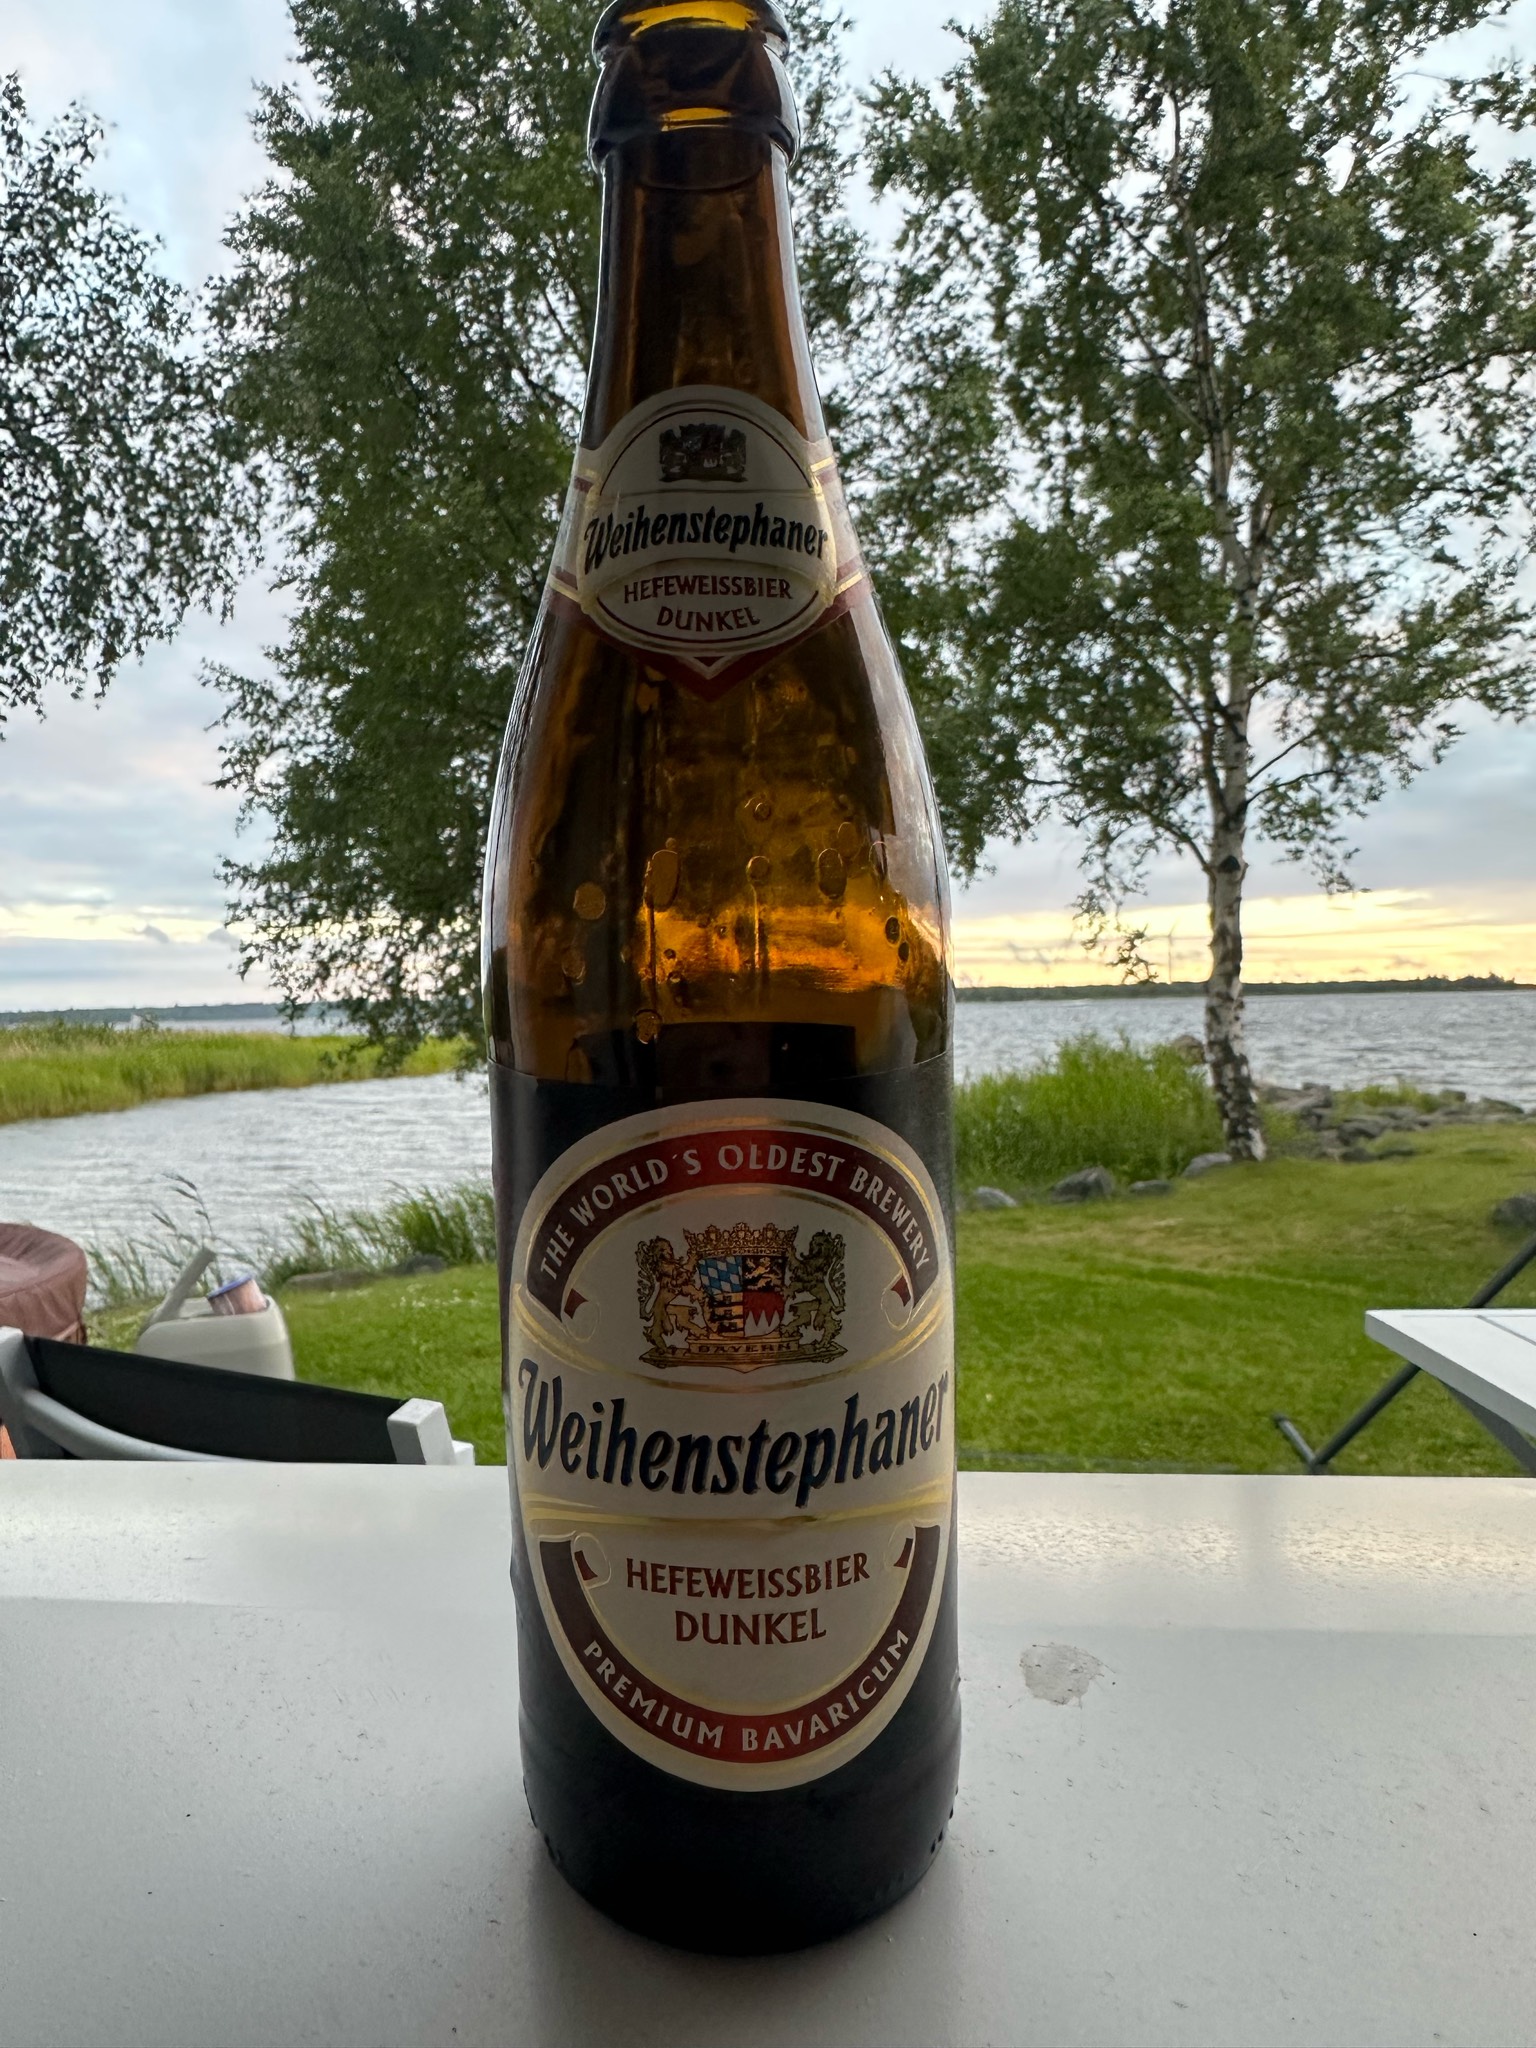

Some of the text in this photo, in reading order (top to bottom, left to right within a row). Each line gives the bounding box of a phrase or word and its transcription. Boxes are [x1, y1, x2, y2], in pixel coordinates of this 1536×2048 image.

[583, 502, 828, 575] Weihenstephaner
[623, 575, 792, 603] HEFEWEISSBIER
[656, 605, 761, 632] DUNKEL
[539, 1224, 575, 1282] THE
[717, 1143, 846, 1183] OLDEST
[849, 1165, 930, 1271] BREWERY
[518, 1357, 950, 1509] Weihenstephaner
[626, 1552, 871, 1599] HEFEWEISSBIER
[674, 1607, 828, 1647] DUNKEL
[582, 1628, 911, 1753] PREMIUM BAVARICUM
